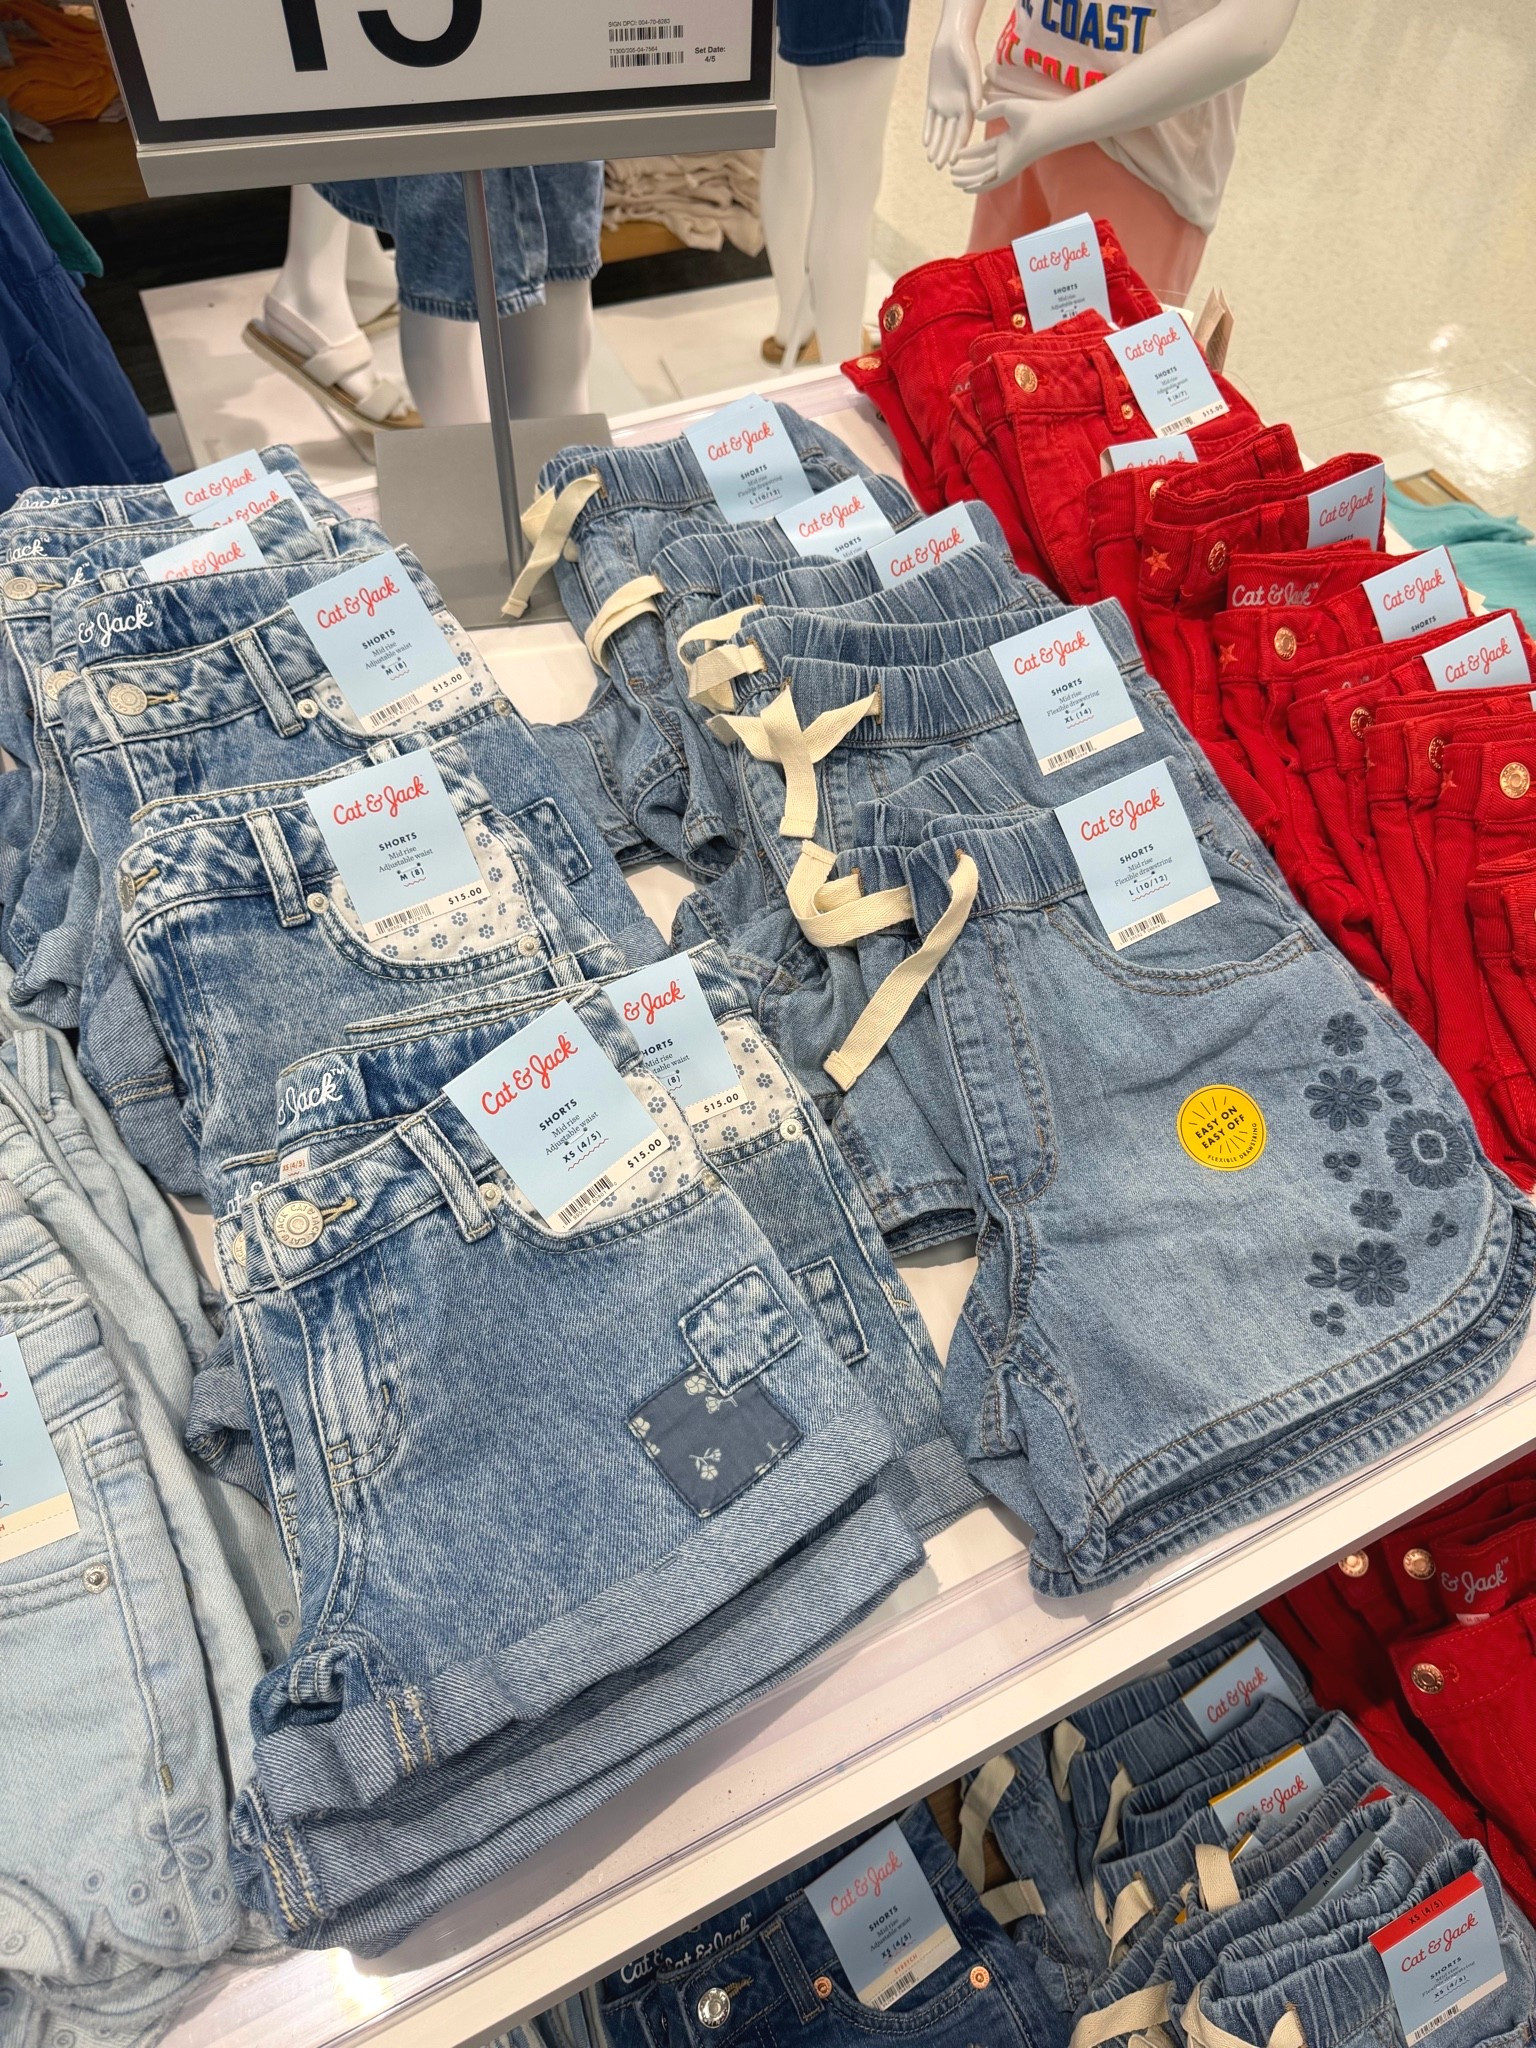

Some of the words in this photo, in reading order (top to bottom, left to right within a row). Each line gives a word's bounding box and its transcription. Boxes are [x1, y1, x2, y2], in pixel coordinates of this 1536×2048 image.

[1029, 255, 1050, 272] Cat
[1050, 252, 1062, 266] &
[1062, 242, 1090, 272] Jack
[1053, 284, 1078, 295] SHORTS
[1124, 342, 1145, 361] Cat
[1144, 340, 1154, 353] &
[1154, 327, 1180, 356] Jack
[1154, 366, 1178, 380] SHORTS
[1202, 404, 1224, 418] $15.00
[708, 443, 730, 462] Cat
[729, 437, 742, 451] &
[742, 422, 774, 454] Jack
[740, 464, 768, 480] SHORTS
[185, 489, 210, 506] Cat
[208, 482, 222, 496] &
[222, 468, 256, 496] Jack
[798, 518, 821, 538] Cat
[820, 512, 834, 526] &
[832, 496, 865, 528] Jack
[1320, 506, 1338, 527] Cat
[1338, 501, 1350, 517] &
[1348, 487, 1375, 521] Jack
[835, 536, 862, 552] SHORTS
[890, 556, 914, 578] Cat
[914, 548, 928, 564] &
[927, 528, 964, 564] Jack
[192, 559, 207, 575] &
[206, 542, 246, 573] Jack
[1232, 584, 1265, 608] Cat
[1268, 584, 1284, 605] &
[1382, 590, 1404, 612] Cat
[1404, 584, 1416, 600] &
[1416, 568, 1446, 604] Jack
[316, 604, 347, 630] Cat
[344, 597, 360, 614] &
[358, 575, 400, 616] Jack
[78, 620, 96, 644] &
[1411, 616, 1437, 633] SHORTS
[362, 628, 396, 650] SHORTS
[372, 645, 386, 658] Mid
[384, 642, 398, 652] rise
[365, 650, 398, 670] Adjustable
[1014, 654, 1041, 676] Cat
[1040, 647, 1054, 664] &
[1053, 630, 1090, 668] Jack
[1445, 664, 1468, 684] Cat
[1468, 656, 1480, 672] &
[1481, 640, 1512, 674] Jack
[386, 667, 394, 676] M
[432, 674, 462, 693] $15.00
[1051, 678, 1083, 696] SHORTS
[1059, 694, 1072, 704] Mid
[1075, 708, 1092, 720] (14)
[333, 800, 366, 825] Cat
[366, 793, 383, 813] &
[383, 776, 430, 818] Jack
[1080, 816, 1110, 841] Cat
[1109, 808, 1124, 828] &
[1124, 788, 1165, 831] Jack
[378, 832, 418, 852] SHORTS
[388, 850, 402, 861] Mid
[402, 846, 416, 856] rise
[1120, 844, 1154, 864] SHORTS
[378, 855, 414, 874] Adjustable
[412, 848, 434, 862] waist
[1128, 862, 1141, 873] Mid
[1140, 857, 1153, 867] rise
[400, 874, 408, 882] M
[411, 868, 424, 878] (8)
[1114, 872, 1140, 888] Flexible
[1136, 874, 1168, 895] (10/12)
[448, 886, 482, 906] $15.00
[624, 1002, 640, 1022] &
[640, 980, 686, 1025] Jack
[645, 1058, 659, 1069] Mid
[660, 1052, 673, 1065] rise
[671, 1054, 690, 1066] waist
[481, 1081, 518, 1115] Cat
[512, 1068, 534, 1090] &
[529, 1034, 579, 1090] Jack
[667, 1074, 681, 1086] (8)
[539, 1098, 578, 1131] SHORTS
[704, 1092, 740, 1113] $15.00
[546, 1126, 580, 1156] Adjustable
[580, 1112, 599, 1128] waist
[552, 1123, 568, 1138] Mid
[566, 1114, 580, 1128] rise
[1195, 1118, 1220, 1139] EASY
[1221, 1105, 1238, 1120] ON
[1202, 1128, 1226, 1149] EASY
[1227, 1114, 1244, 1130] OFF
[562, 1150, 576, 1163] XS
[577, 1130, 602, 1153] (4/5)
[627, 1138, 662, 1168] $15.00
[1208, 1154, 1238, 1163] FLEXIBLE
[1239, 1122, 1258, 1160] DRAWSTRING
[1441, 1572, 1459, 1592] &
[1206, 1698, 1228, 1725] Cat
[1226, 1688, 1240, 1708] &
[1238, 1666, 1268, 1707] Jack
[1260, 1798, 1274, 1813] &
[1273, 1774, 1308, 1814] Jack
[829, 1892, 857, 1918] Cat
[854, 1876, 870, 1898] &
[868, 1851, 904, 1896] Jack
[1322, 1879, 1330, 1888] M
[1331, 1868, 1342, 1880] (8)
[868, 1905, 898, 1932] SHORTS
[1408, 1914, 1421, 1925] XS
[1422, 1899, 1444, 1916] (4/5)
[876, 1926, 888, 1938] Mid
[1401, 1949, 1427, 1972] Cat
[1428, 1938, 1442, 1954] &
[1442, 1912, 1479, 1952] Jack
[881, 1948, 892, 1958] XS
[894, 1953, 918, 1974] STRETCH
[1430, 1956, 1462, 1980] SHORTS
[1434, 1988, 1444, 1999] XS
[1446, 1975, 1467, 1990] (4/5)
